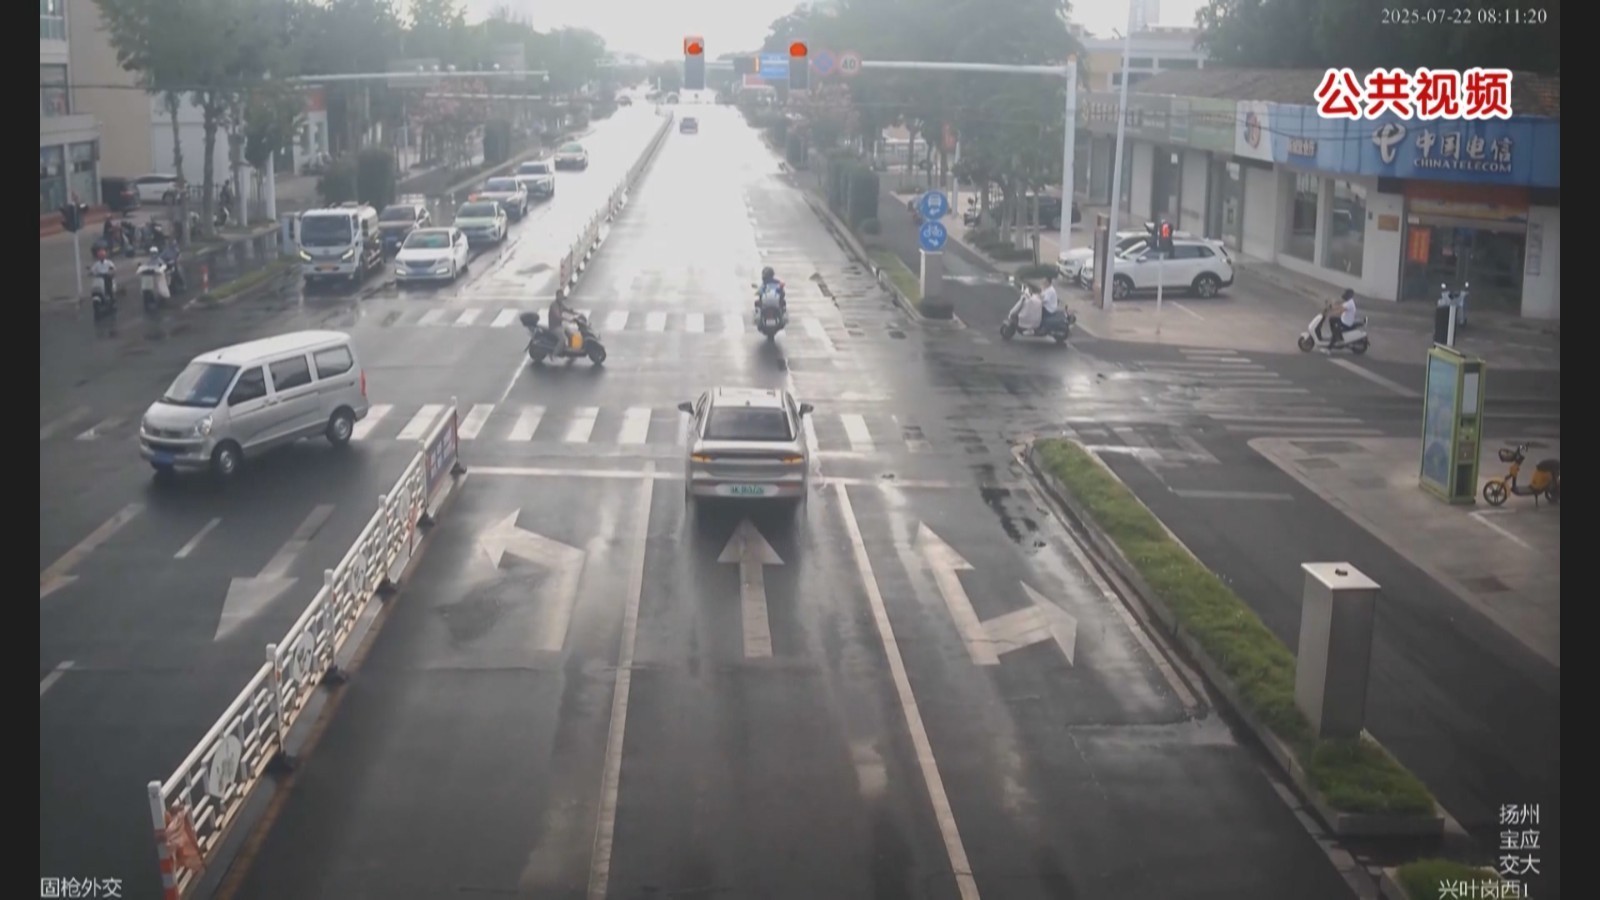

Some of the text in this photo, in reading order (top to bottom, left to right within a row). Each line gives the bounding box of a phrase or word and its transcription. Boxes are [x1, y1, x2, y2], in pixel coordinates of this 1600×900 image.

[841, 57, 856, 70] 40
[1415, 128, 1513, 163] 中国电信
